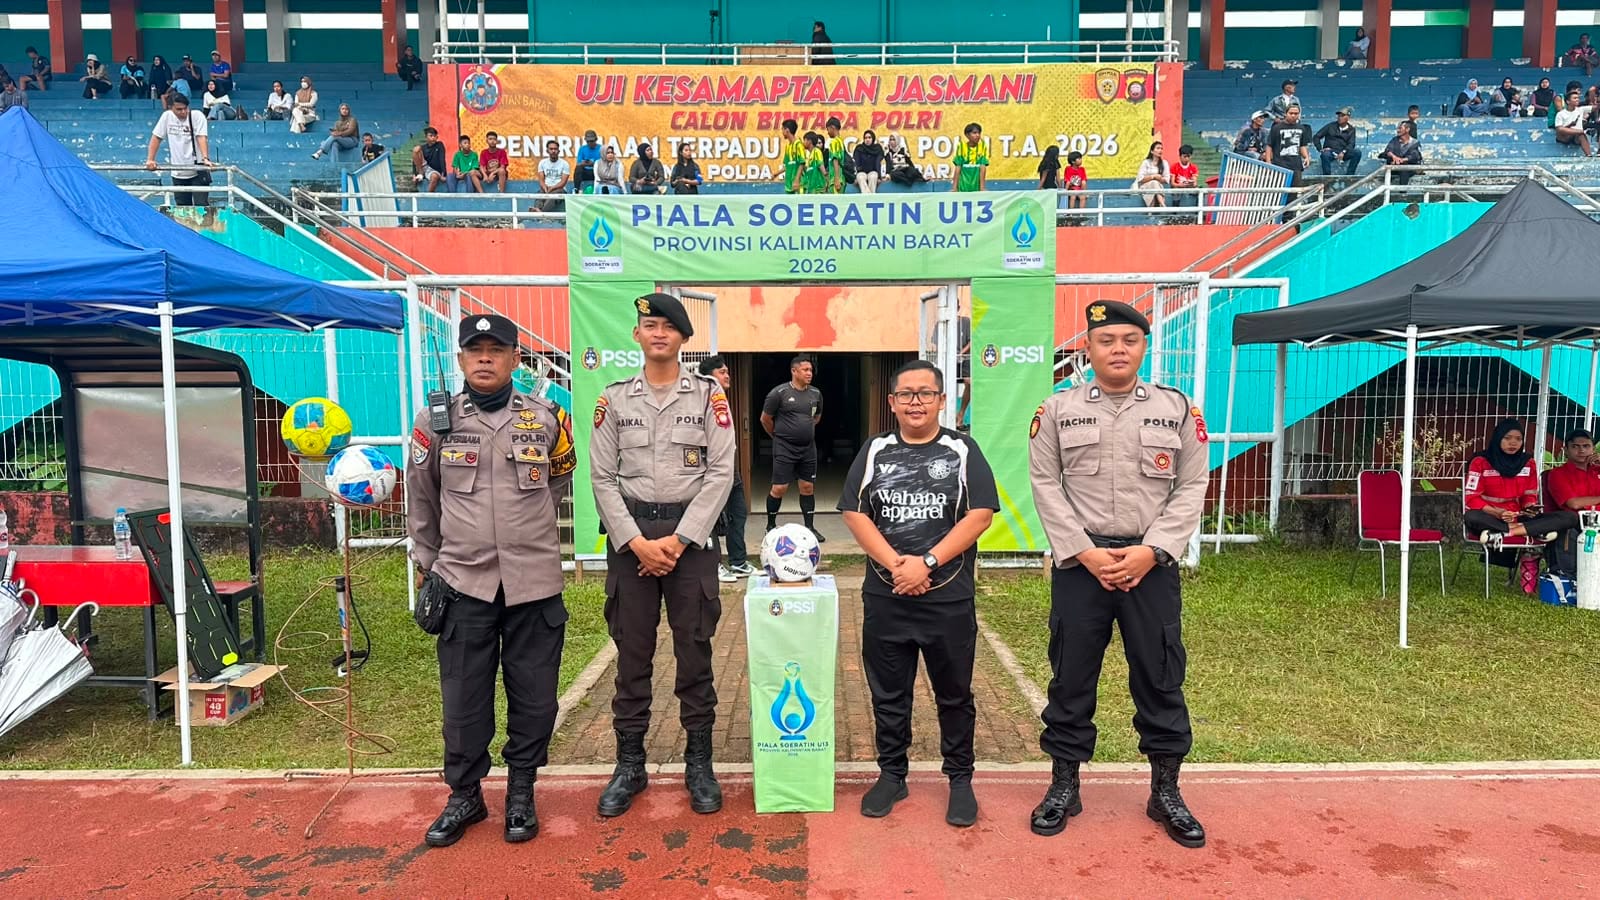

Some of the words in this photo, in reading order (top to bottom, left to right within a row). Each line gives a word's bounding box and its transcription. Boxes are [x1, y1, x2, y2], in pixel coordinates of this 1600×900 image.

[574, 74, 626, 104] UJI
[632, 74, 879, 104] KESAMAPTAAN
[886, 73, 1036, 104] JASMANI
[670, 111, 748, 131] CALON
[870, 110, 943, 130] POLRI
[667, 136, 780, 159] TERPADU
[1055, 134, 1118, 157] 2026
[707, 164, 772, 180] POLDA
[632, 203, 735, 227] PIALA
[748, 201, 921, 226] SOERATIN
[938, 200, 994, 224] U13
[653, 235, 752, 252] PROVINSI
[760, 233, 896, 251] KALIMANTAN
[903, 233, 973, 249] BARAT
[788, 258, 837, 274] 2026
[601, 350, 645, 368] PSSI
[1001, 345, 1045, 364] PSSI
[1060, 417, 1097, 429] FACHRI
[1143, 418, 1179, 430] POLRI
[511, 433, 546, 443] POLRI
[877, 489, 947, 506] Wahana
[881, 504, 944, 523] apparel
[784, 601, 815, 614] PSSI
